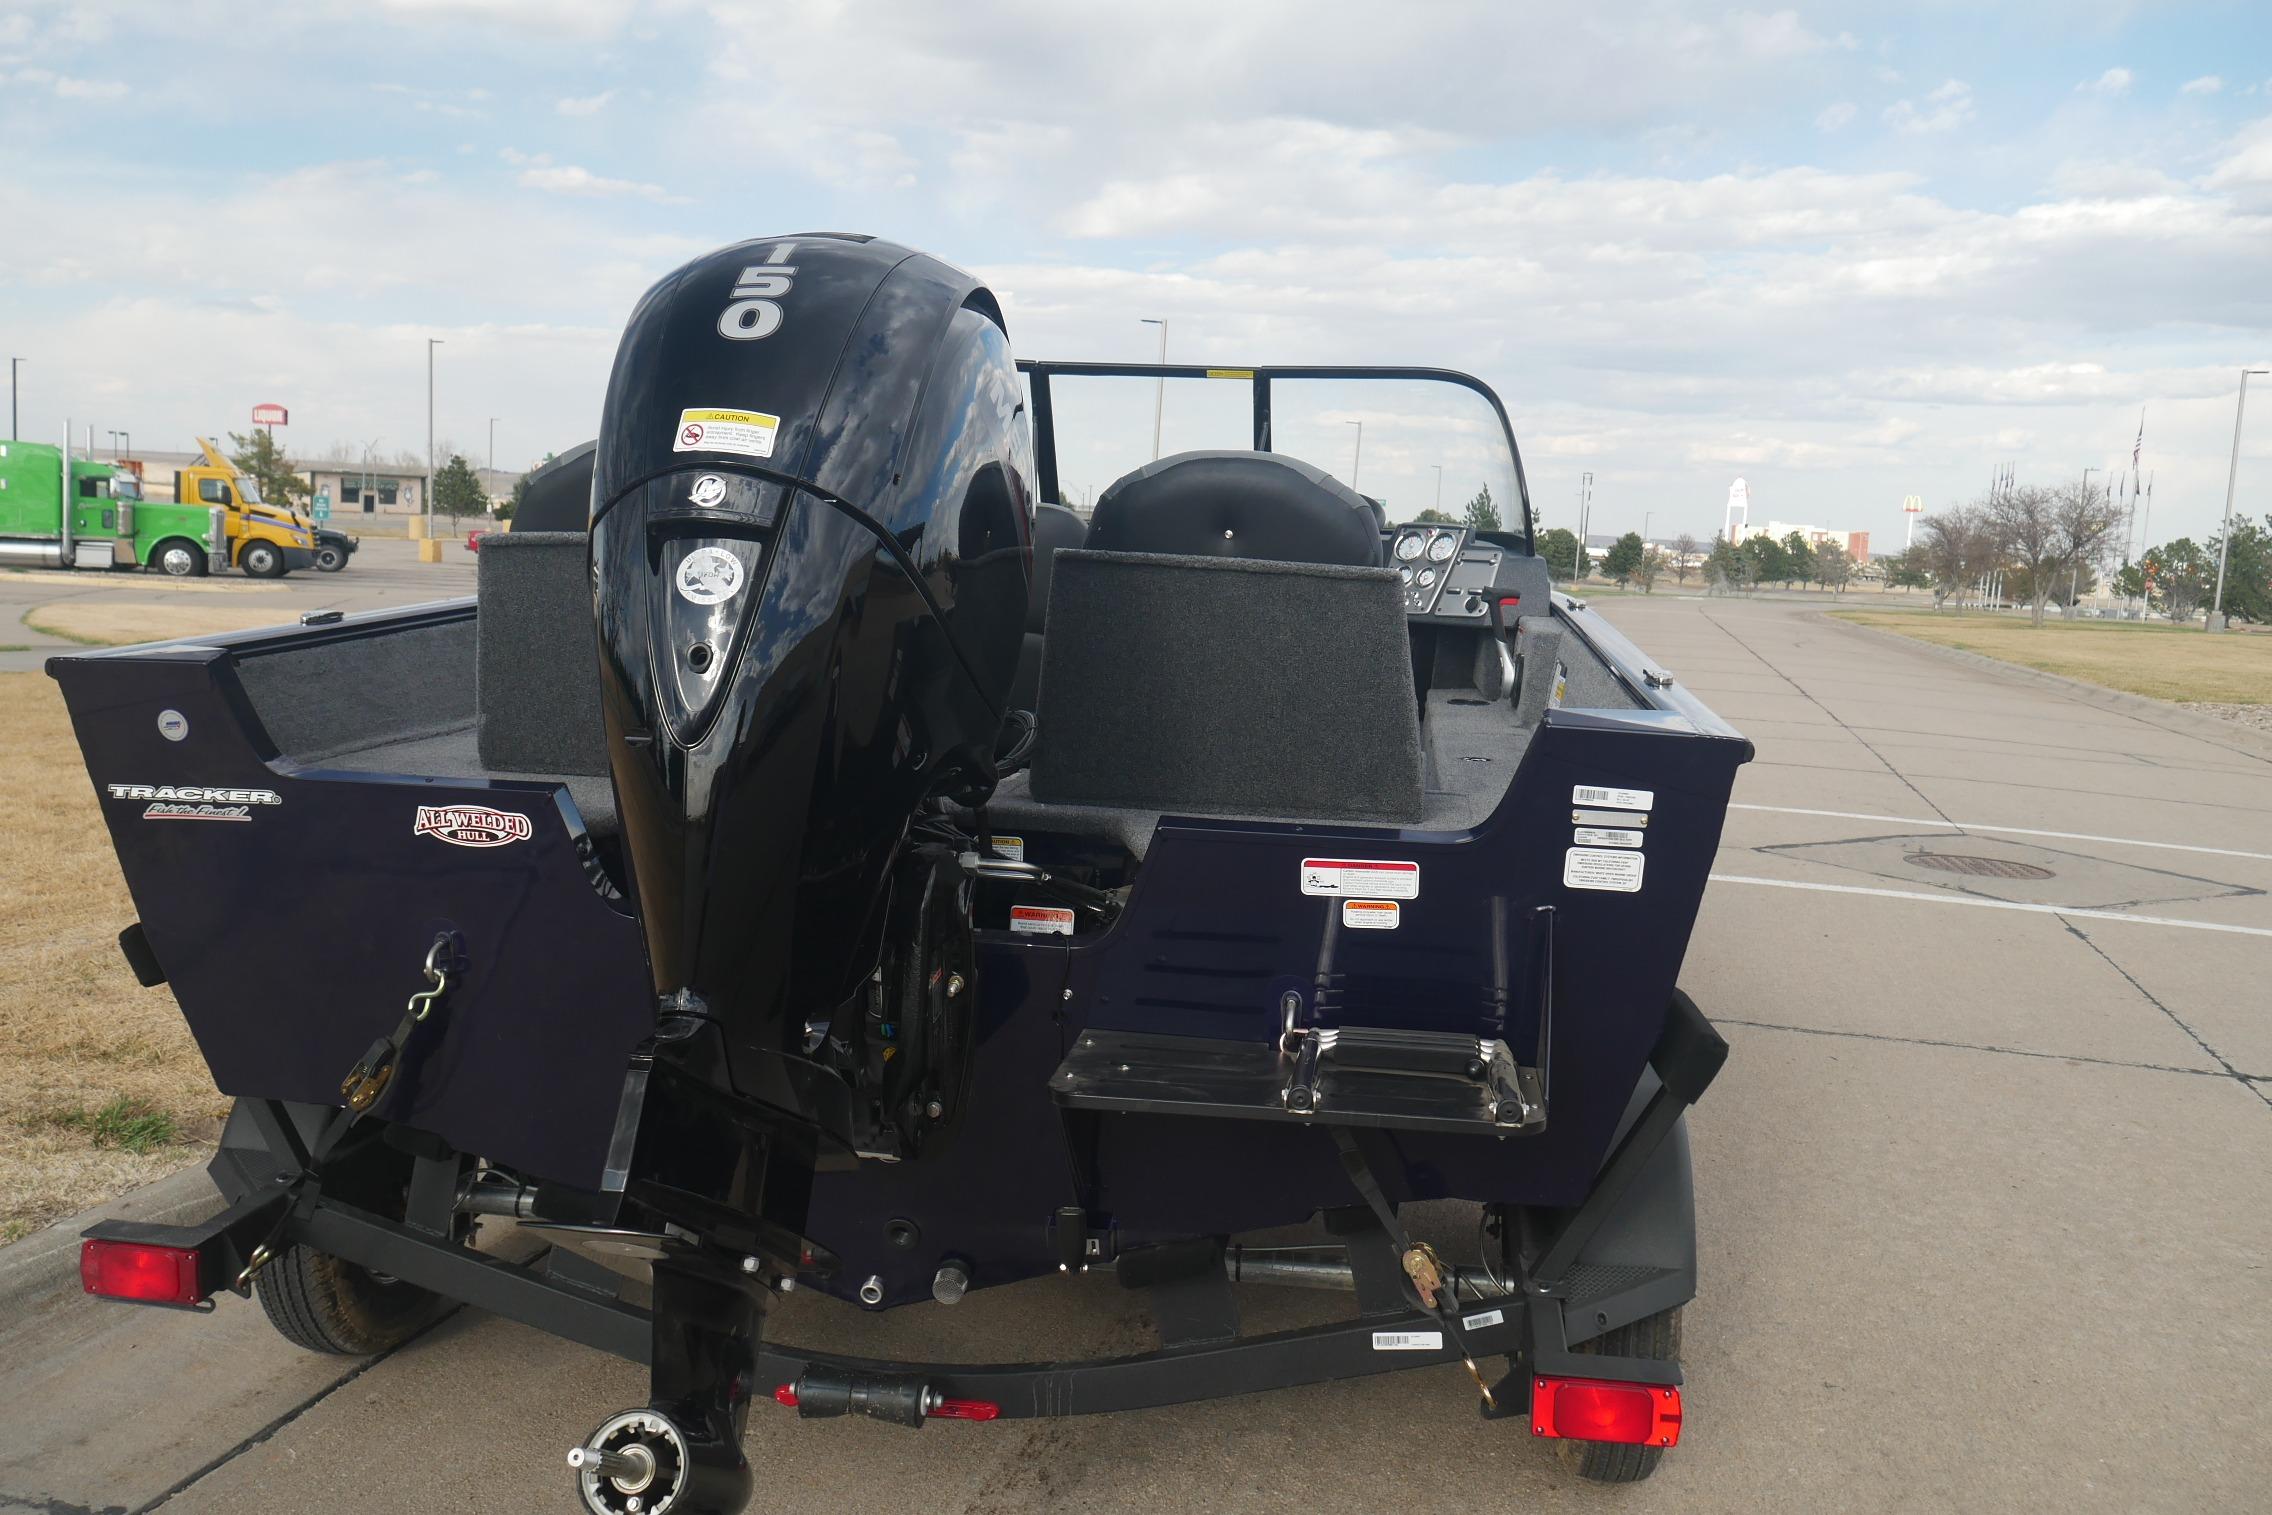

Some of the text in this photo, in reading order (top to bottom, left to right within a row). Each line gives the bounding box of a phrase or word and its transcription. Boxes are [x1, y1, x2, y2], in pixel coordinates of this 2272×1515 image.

[717, 242, 800, 341] 150
[714, 413, 750, 423] CAUTION
[109, 784, 276, 804] TRACKER
[417, 808, 529, 837] ALL WELDED
[456, 830, 491, 842] HULL
